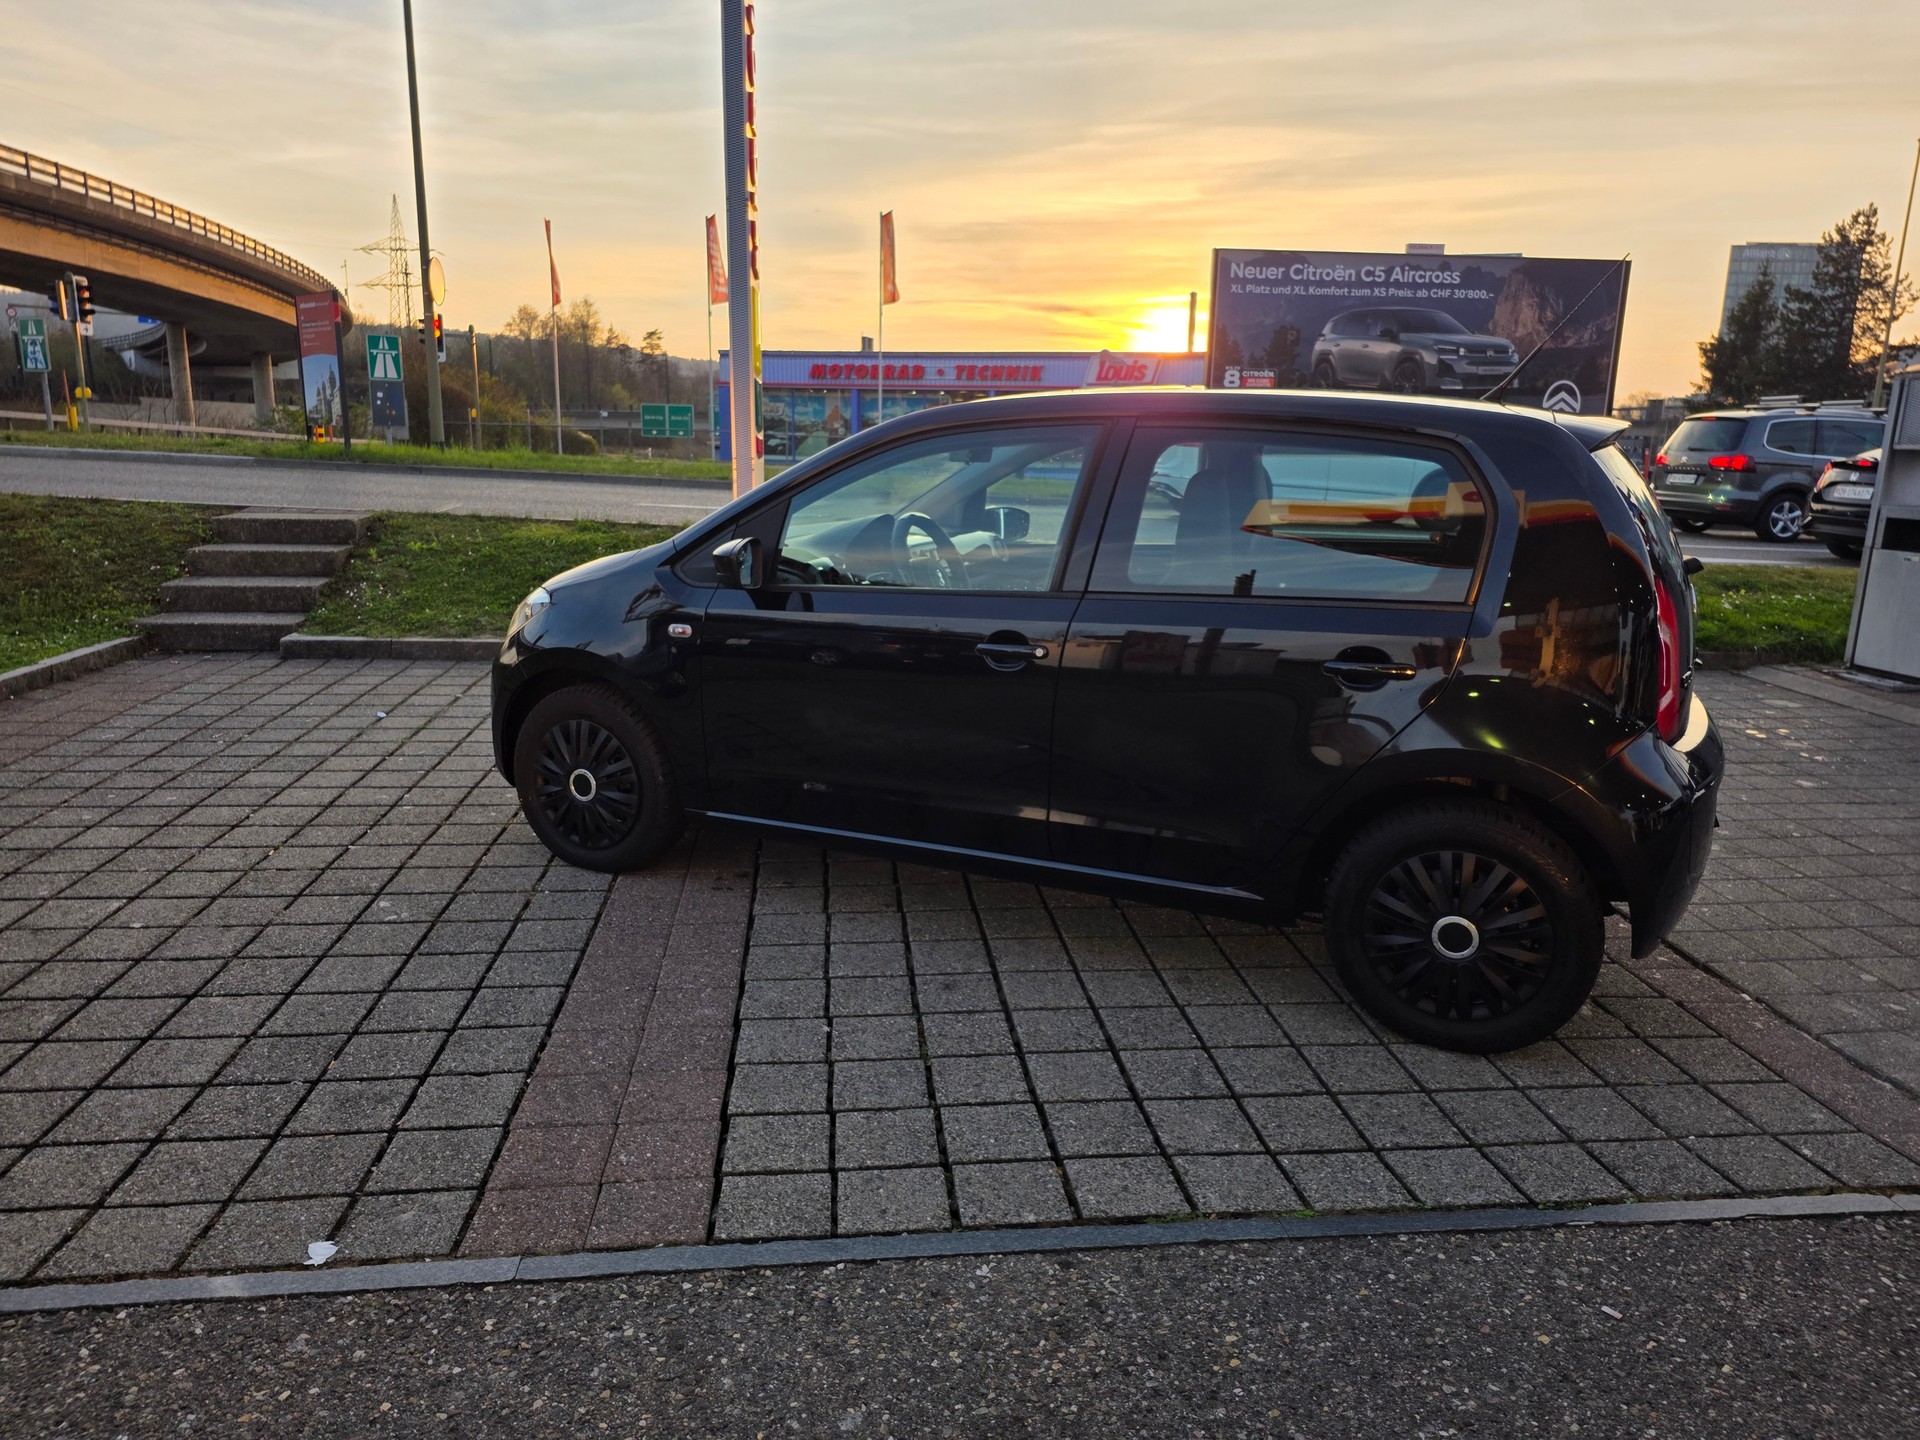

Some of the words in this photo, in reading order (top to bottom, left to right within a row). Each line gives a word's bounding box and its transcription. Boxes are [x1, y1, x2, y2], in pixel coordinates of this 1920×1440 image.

[1230, 262, 1285, 280] Neuer
[1289, 263, 1356, 282] Citroën
[1360, 265, 1386, 282] C5
[1389, 266, 1461, 284] Aircross
[1230, 284, 1243, 293] XL
[1246, 284, 1270, 294] Platz
[1272, 285, 1291, 294] und
[1293, 286, 1306, 295] XL
[1308, 286, 1349, 296] Komfort
[1350, 289, 1371, 297] zum
[1373, 287, 1387, 297] XS
[1388, 288, 1415, 297] Preis:
[1416, 288, 1428, 298] ab
[1430, 289, 1452, 298] CHF
[809, 363, 926, 380] MOTORRAD
[954, 364, 1045, 381] TECHNIK
[1095, 359, 1148, 382] Louis
[1223, 369, 1241, 388] 8
[1242, 369, 1275, 378] CITROËN
